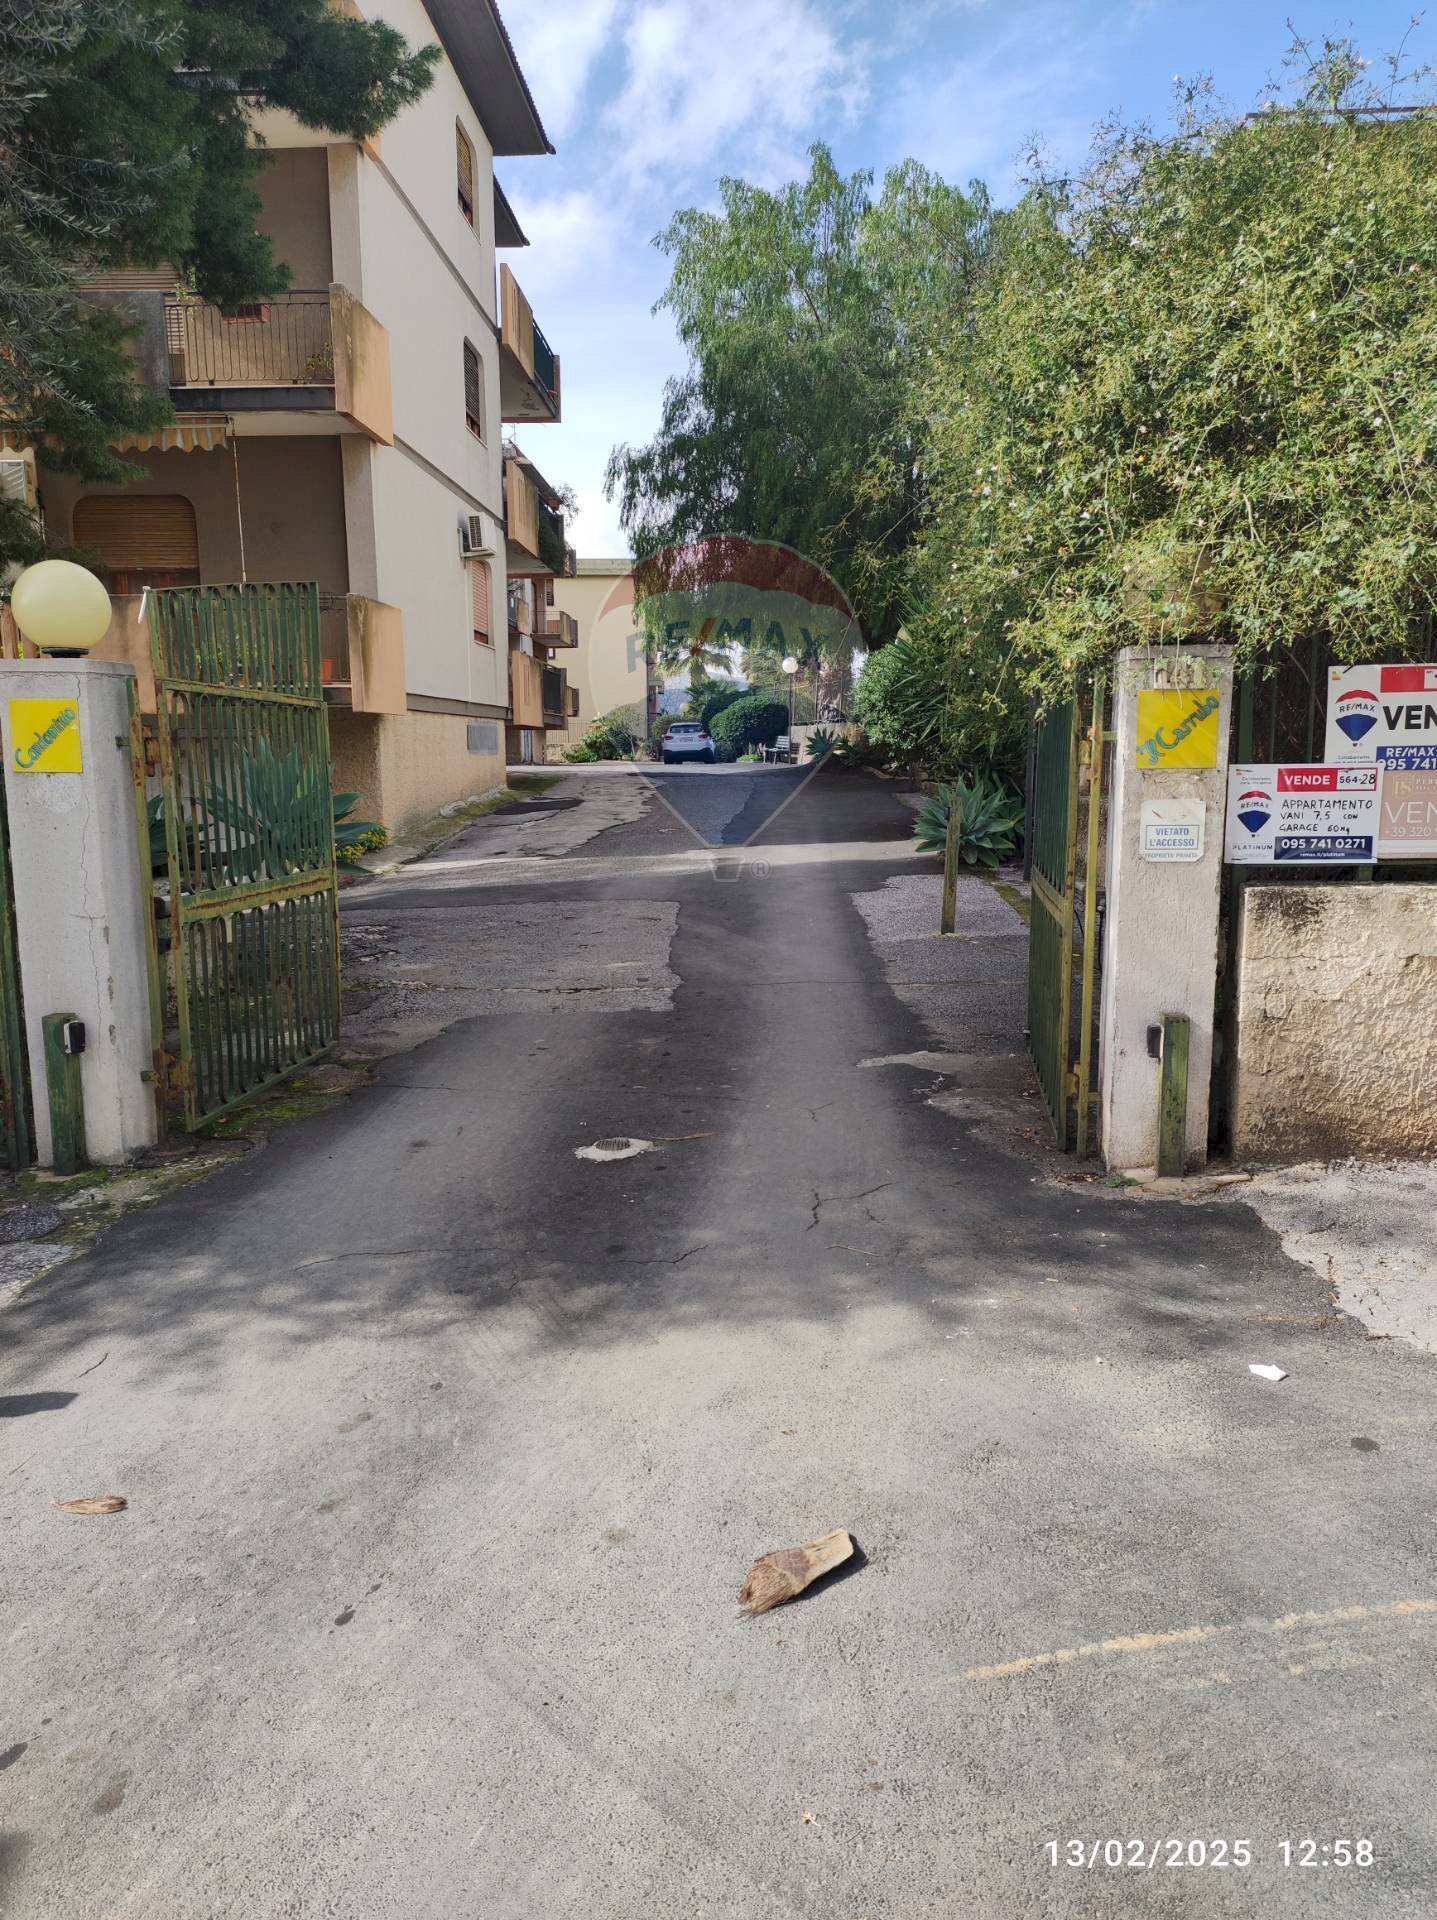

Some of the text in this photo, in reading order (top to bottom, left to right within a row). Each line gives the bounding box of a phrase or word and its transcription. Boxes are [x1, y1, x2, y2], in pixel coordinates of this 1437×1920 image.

[1339, 702, 1376, 713] RE/MAX
[1386, 747, 1434, 758] RE/MAX
[1284, 775, 1331, 786] VENDE
[1339, 773, 1376, 785] 564-28
[1281, 799, 1373, 810] APPARTAMENTO
[1280, 811, 1304, 820] VANI
[1155, 827, 1190, 836] VIETATO
[1279, 823, 1319, 832] GARAGE
[1149, 838, 1195, 847] L'ACCESSO
[1281, 838, 1366, 849] 095 741 0271
